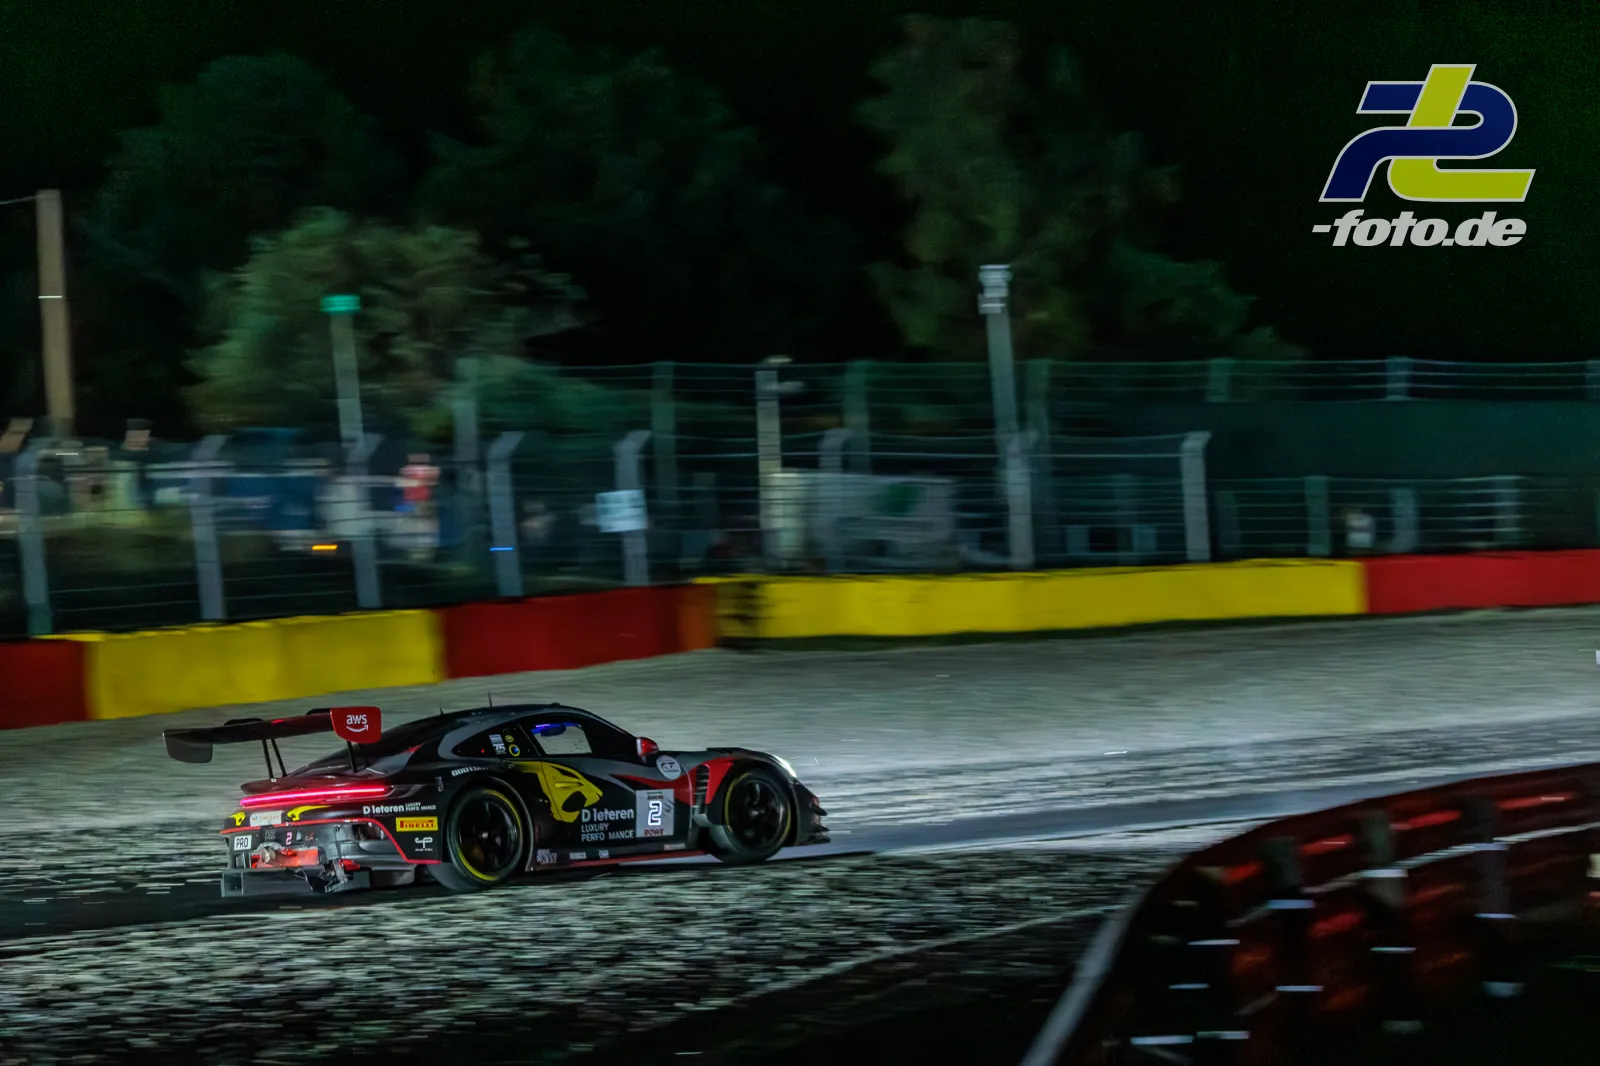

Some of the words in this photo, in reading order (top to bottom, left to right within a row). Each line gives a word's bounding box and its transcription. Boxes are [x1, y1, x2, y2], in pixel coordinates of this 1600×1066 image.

[346, 714, 368, 725] aws
[647, 800, 663, 826] 2
[399, 820, 434, 829] PIRELLI
[581, 822, 609, 833] LUXURY
[235, 837, 249, 848] PRO
[285, 832, 293, 845] 2
